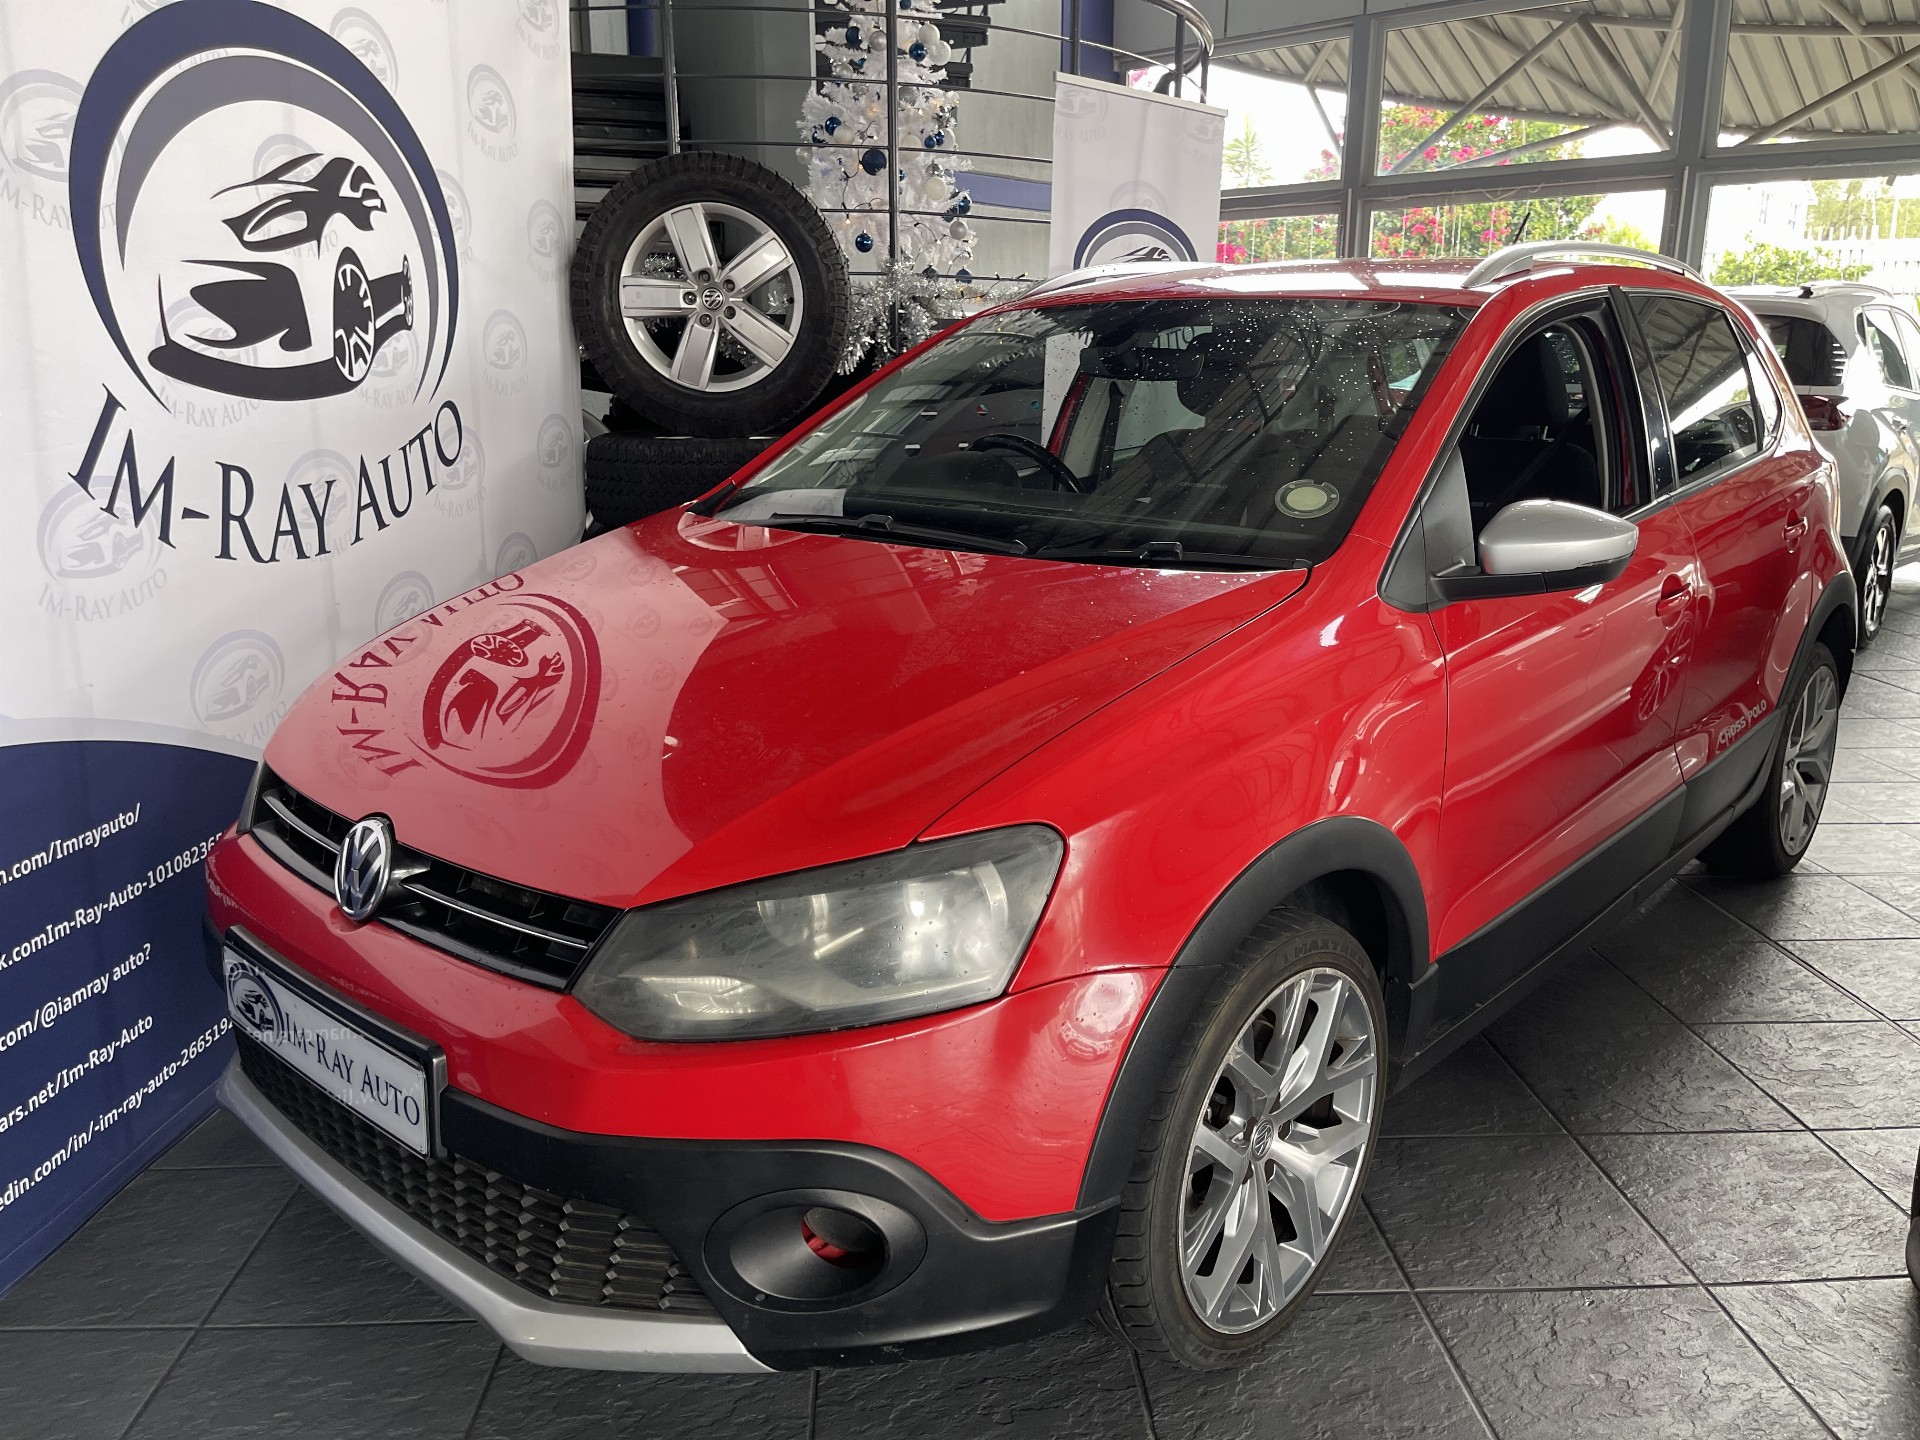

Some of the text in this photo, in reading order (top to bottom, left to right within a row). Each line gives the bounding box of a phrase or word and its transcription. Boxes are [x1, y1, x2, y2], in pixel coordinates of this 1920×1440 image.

[68, 383, 464, 564] IM-RAY AUTO
[119, 567, 168, 616] AUTO
[1746, 699, 1767, 723] POLO
[113, 942, 152, 982] auto?
[284, 1012, 420, 1126] IM-RAY AUTO
